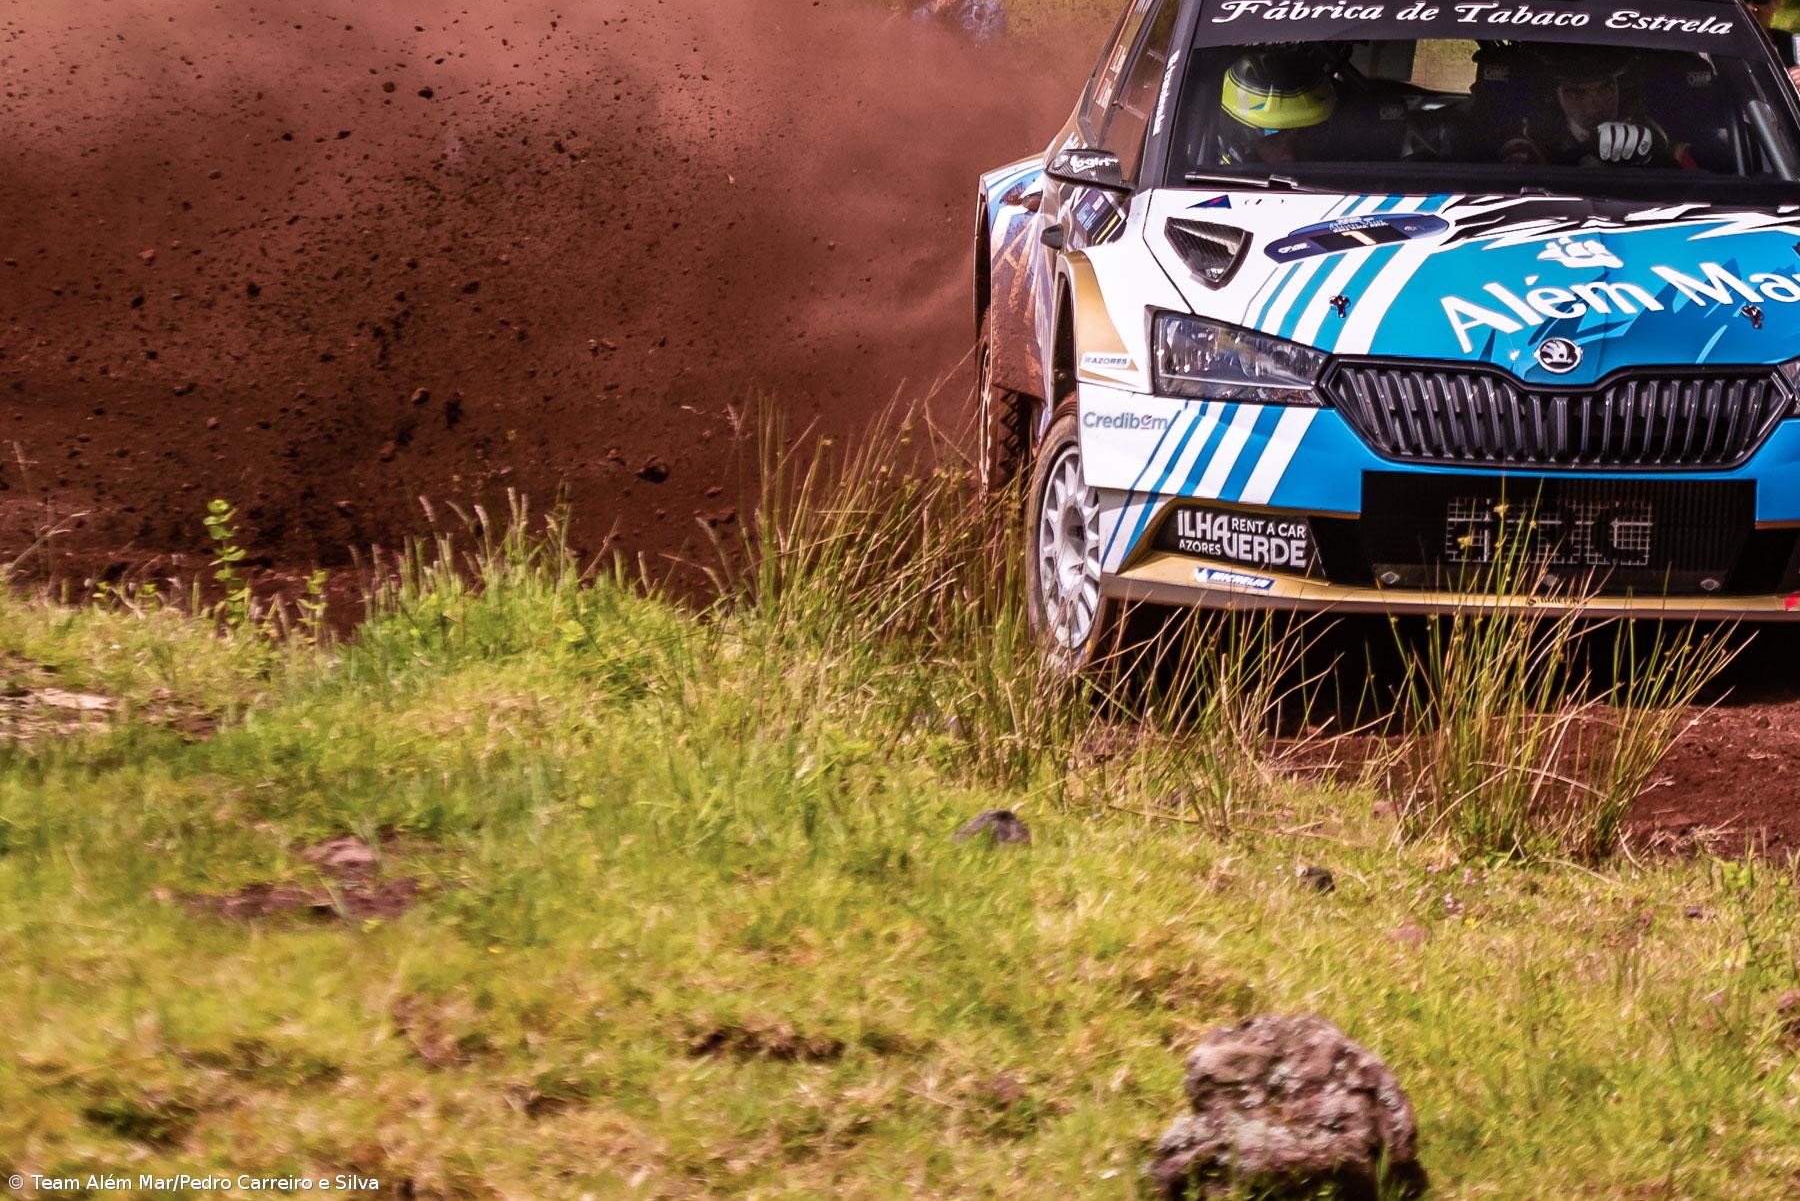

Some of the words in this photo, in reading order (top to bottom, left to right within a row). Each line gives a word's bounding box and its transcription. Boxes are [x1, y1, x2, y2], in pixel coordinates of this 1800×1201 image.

[1396, 0, 1441, 22] de
[1454, 0, 1590, 27] Tabaco
[1605, 10, 1735, 36] Estrela
[1440, 274, 1665, 354] Além
[1177, 509, 1229, 541] ILHA
[1232, 517, 1265, 534] RENT
[1266, 521, 1276, 536] A
[1278, 522, 1306, 539] CAR
[1179, 538, 1222, 556] AZORES
[1209, 570, 1272, 587] MICHELIN
